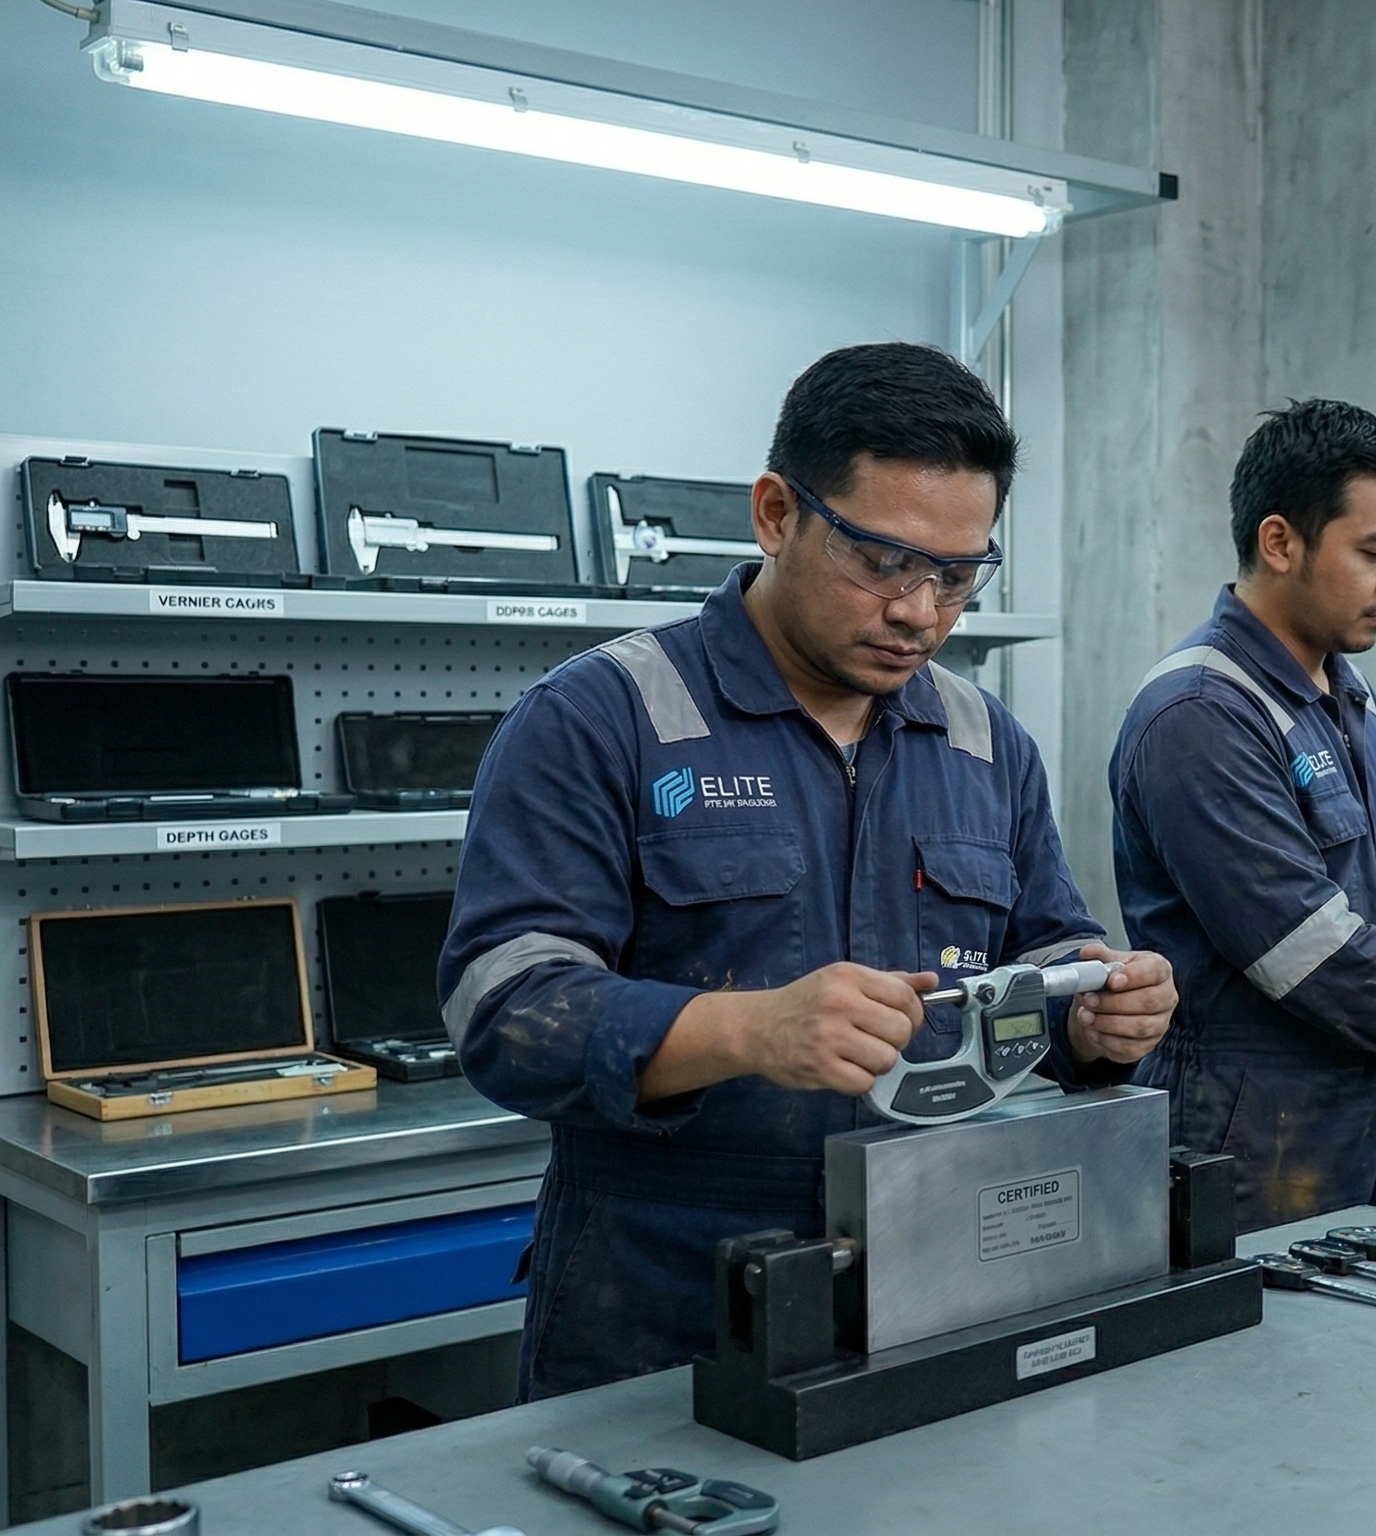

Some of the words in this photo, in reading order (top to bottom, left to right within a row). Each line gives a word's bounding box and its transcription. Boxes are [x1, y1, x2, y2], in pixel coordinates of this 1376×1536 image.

[158, 595, 221, 608] VERNIER
[700, 776, 774, 797] ELITE
[166, 826, 214, 843] DEPTH
[219, 823, 268, 841] GAGES
[998, 1181, 1060, 1204] CERTIFIED
